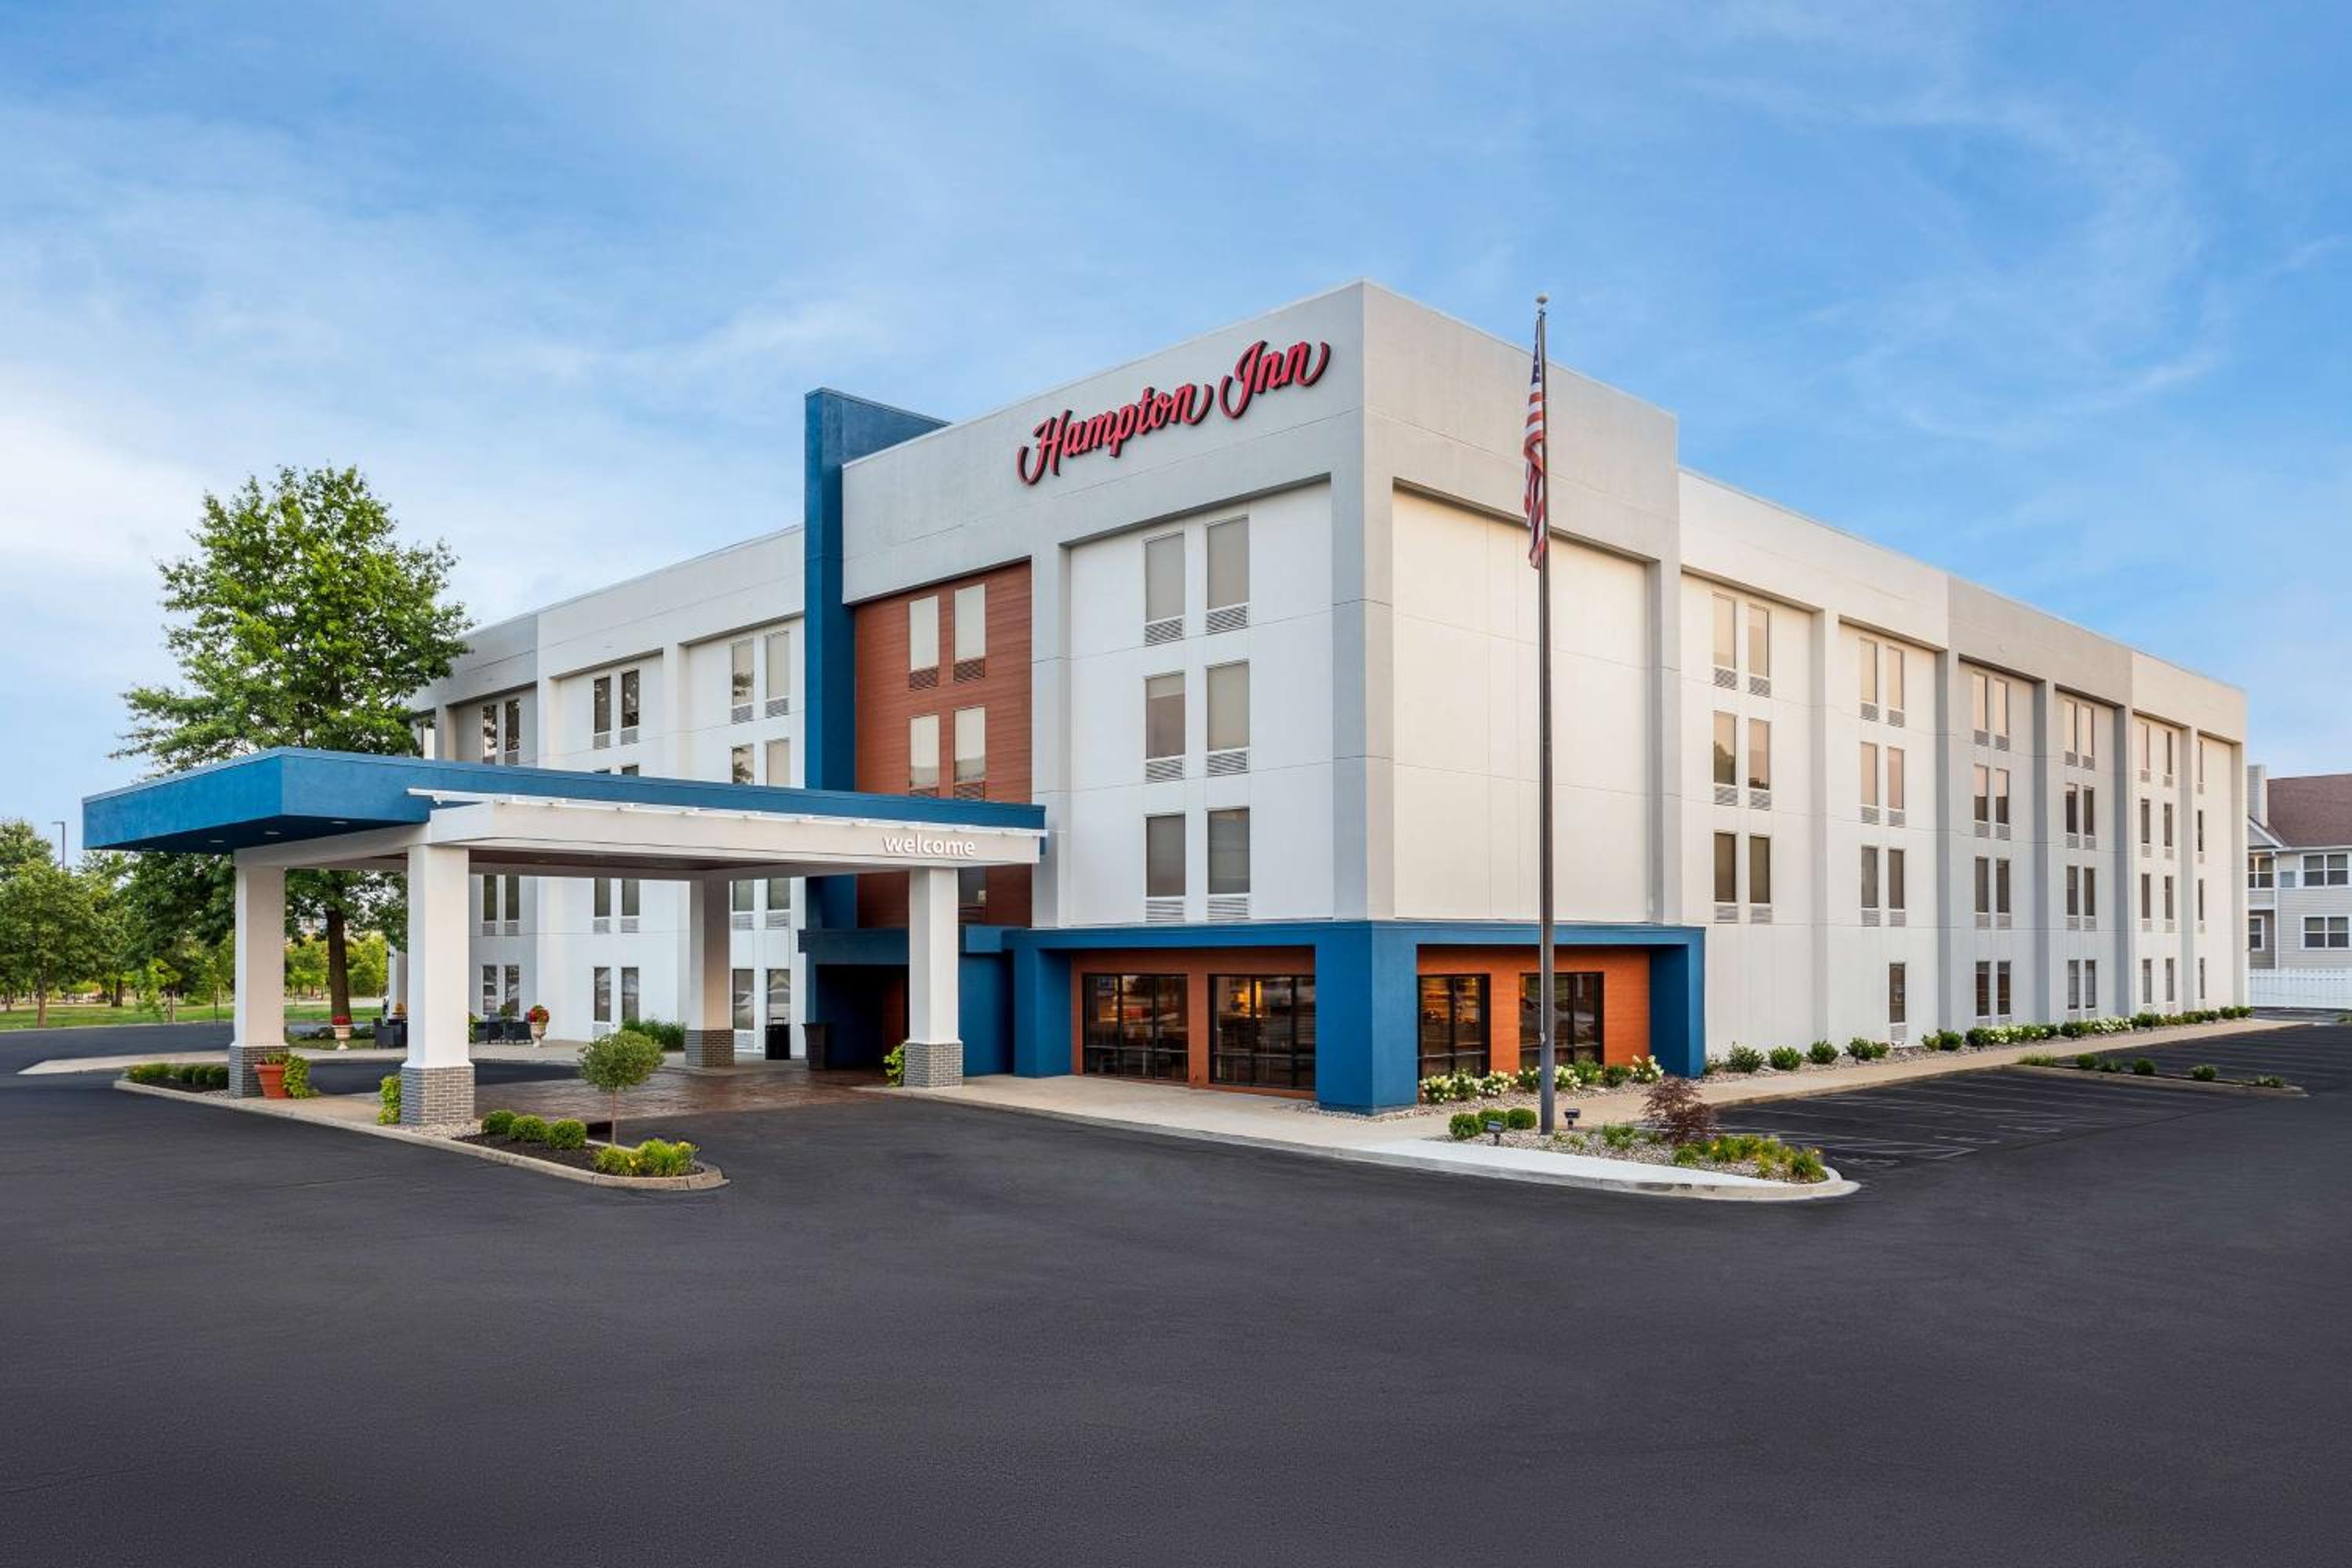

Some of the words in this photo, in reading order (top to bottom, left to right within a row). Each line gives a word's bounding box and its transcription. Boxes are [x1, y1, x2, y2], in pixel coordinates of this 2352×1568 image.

[1018, 383, 1214, 485] Hampton
[1220, 340, 1330, 419] Inn
[884, 833, 976, 855] welcome
